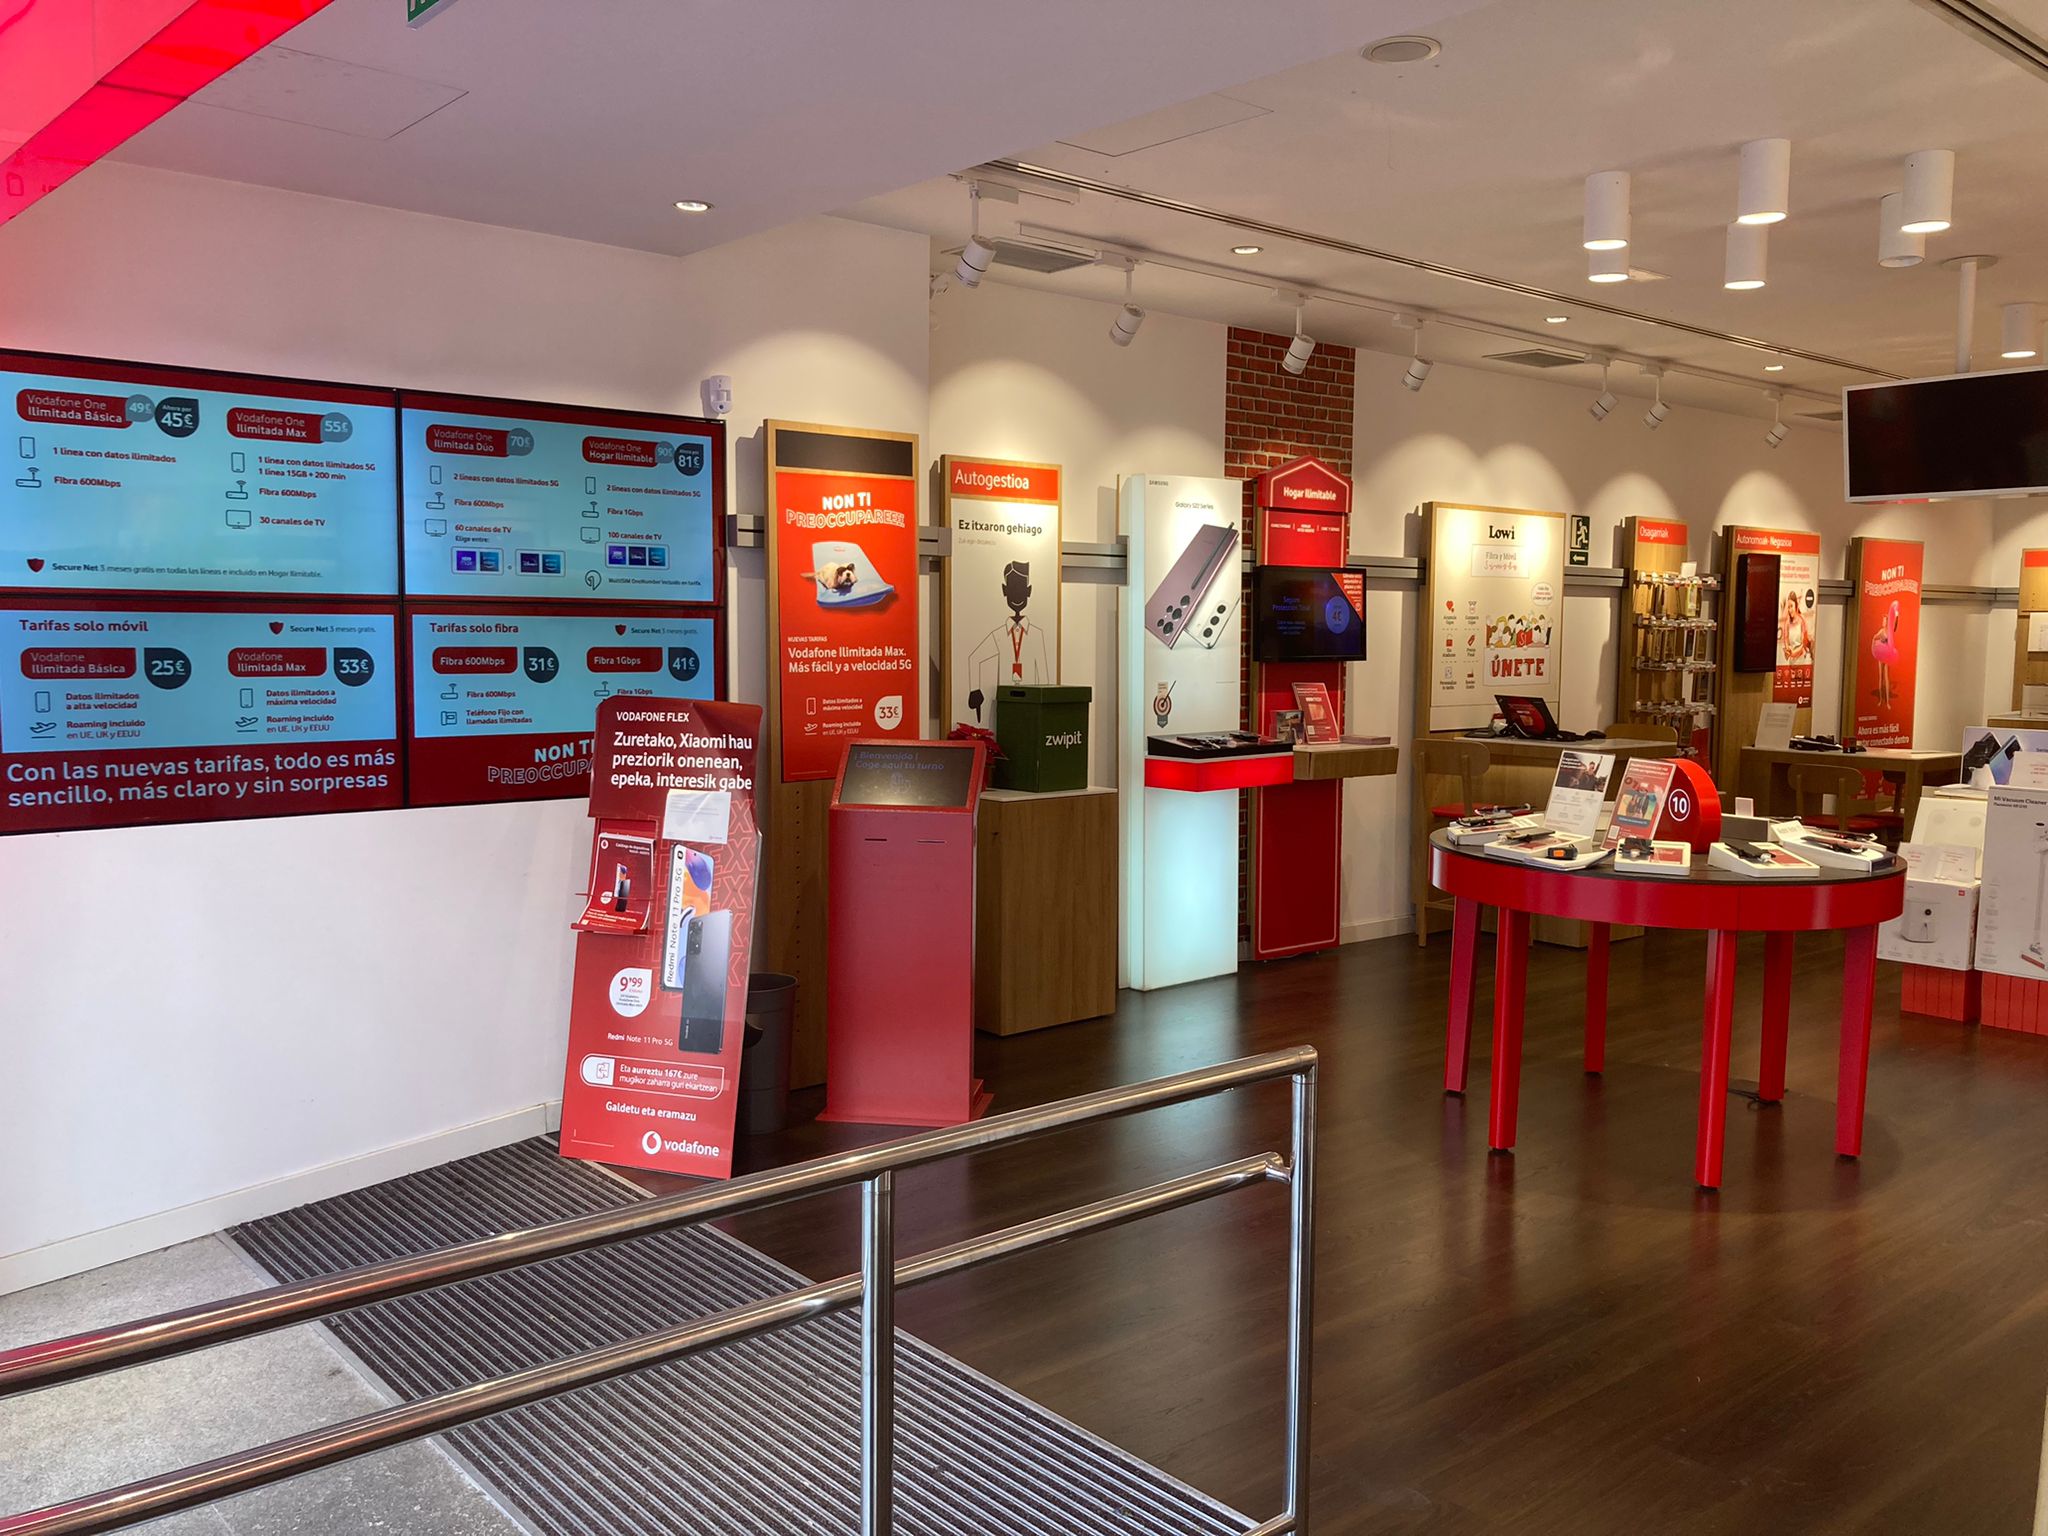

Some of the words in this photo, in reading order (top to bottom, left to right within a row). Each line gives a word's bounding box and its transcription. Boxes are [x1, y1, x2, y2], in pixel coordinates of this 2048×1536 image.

[26, 394, 80, 408] Vodafone
[84, 399, 106, 410] One
[28, 407, 81, 420] Ilimitada
[85, 411, 122, 423] Básica
[161, 413, 193, 428] 45€
[236, 413, 283, 425] Vodafone
[285, 417, 304, 426] One
[237, 424, 283, 436] Ilimitada
[286, 429, 307, 438] Max
[434, 429, 474, 440] Vodafone
[476, 433, 493, 441] One
[434, 440, 474, 450] Ilimitada
[589, 441, 624, 451] Vodafone
[105, 451, 130, 459] datos
[132, 453, 176, 463] ilimitados
[589, 451, 613, 461] Hogar
[616, 453, 653, 463] Ilimitable
[678, 455, 700, 468] 81€
[54, 476, 77, 485] Fibra
[80, 478, 121, 488] 600Mbps
[955, 469, 1030, 491] Autogestioa
[259, 488, 279, 496] Fibra
[1283, 486, 1304, 500] Hogar
[1305, 488, 1336, 501] Ilimitable
[822, 494, 855, 510] NON
[857, 492, 871, 506] TI
[959, 519, 970, 530] Ez
[972, 520, 1005, 532] itxaron
[1007, 523, 1042, 536] gehiago
[1489, 525, 1515, 540] Lowi
[1882, 567, 1897, 580] NON
[1898, 565, 1904, 577] TI
[20, 620, 70, 631] Tarifas
[74, 621, 103, 631] solo
[108, 621, 148, 632] móvil
[430, 623, 467, 633] Tarifas
[470, 624, 492, 633] solo
[495, 624, 518, 633] fibra
[31, 653, 84, 662] Vodafone
[237, 653, 282, 661] Vodafone
[788, 647, 837, 658] Vodafone
[840, 647, 882, 657] Ilimitada
[885, 646, 906, 656] Max.
[152, 660, 185, 675] 25€
[238, 663, 283, 671] Ilimitada
[286, 663, 306, 671] Max
[340, 659, 368, 673] 33€
[440, 657, 463, 665] Fibra
[465, 657, 505, 666] 600Mbps
[529, 658, 554, 671] 31€
[616, 657, 640, 665] 1Gbps
[673, 658, 696, 670] 41€
[789, 662, 809, 672] Más
[812, 661, 833, 672] fácil
[835, 663, 842, 674] y
[844, 663, 849, 671] a
[851, 660, 897, 670] velocidad
[899, 659, 912, 669] 5G
[1491, 654, 1545, 677] ÚNETE
[32, 665, 85, 674] Ilimitada
[89, 664, 125, 673] Básica
[617, 712, 665, 721] VODAFONE
[667, 713, 689, 722] FLEX
[879, 706, 899, 719] 33€
[614, 732, 676, 749] Zuretako,
[680, 733, 726, 748] Xiaomi
[729, 735, 752, 749] hau
[1045, 731, 1082, 749] zwipit
[535, 742, 574, 763] NON
[7, 763, 56, 783] Con
[63, 761, 98, 780] las
[105, 761, 188, 777] nuevas
[195, 756, 269, 773] tarifas,
[275, 753, 321, 769] todo
[327, 754, 349, 766] es
[355, 749, 395, 766] más
[612, 753, 674, 769] preziorik
[678, 755, 743, 770] onenean,
[611, 772, 654, 789] epeka,
[657, 774, 716, 788] interesik
[719, 775, 752, 792] gabe
[9, 784, 112, 807] sencillo,
[120, 782, 168, 800] más
[174, 779, 230, 797] claro
[236, 781, 248, 798] y
[254, 773, 284, 793] sin
[290, 773, 388, 794] sorpresas
[1672, 797, 1687, 814] 10
[675, 868, 682, 881] 5G
[670, 923, 678, 948] Note
[666, 953, 675, 982] Redmi
[626, 1035, 641, 1043] Note
[620, 1064, 630, 1072] Eta
[632, 1066, 662, 1076] aurreztu
[664, 1070, 682, 1078] 167€
[606, 1101, 640, 1115] Galdetu
[642, 1106, 655, 1117] eta
[657, 1109, 696, 1121] eramazu
[664, 1139, 720, 1157] vodafone
